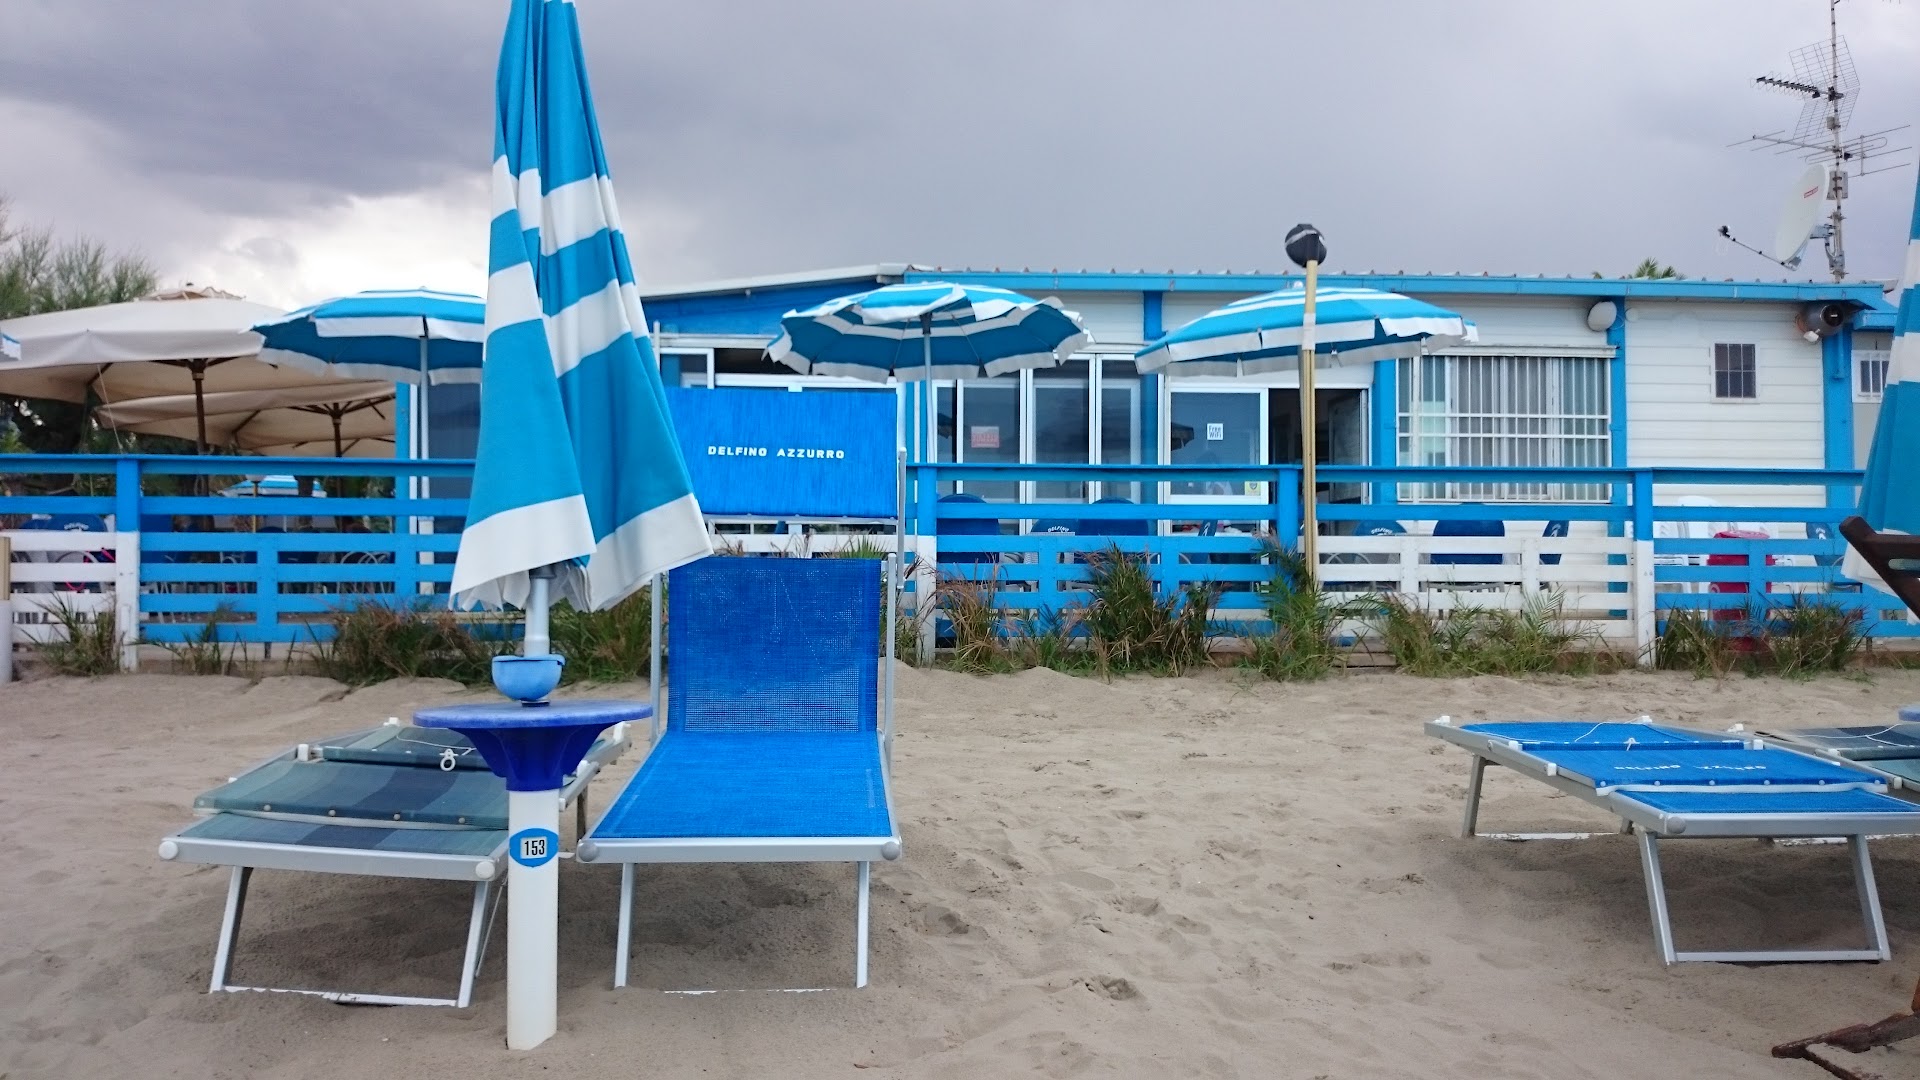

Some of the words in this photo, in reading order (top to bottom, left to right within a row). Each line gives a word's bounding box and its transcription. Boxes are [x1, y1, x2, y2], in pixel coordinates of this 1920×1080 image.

[708, 446, 767, 457] DELFINO
[776, 448, 845, 459] AZZURRO
[524, 839, 545, 856] 153
